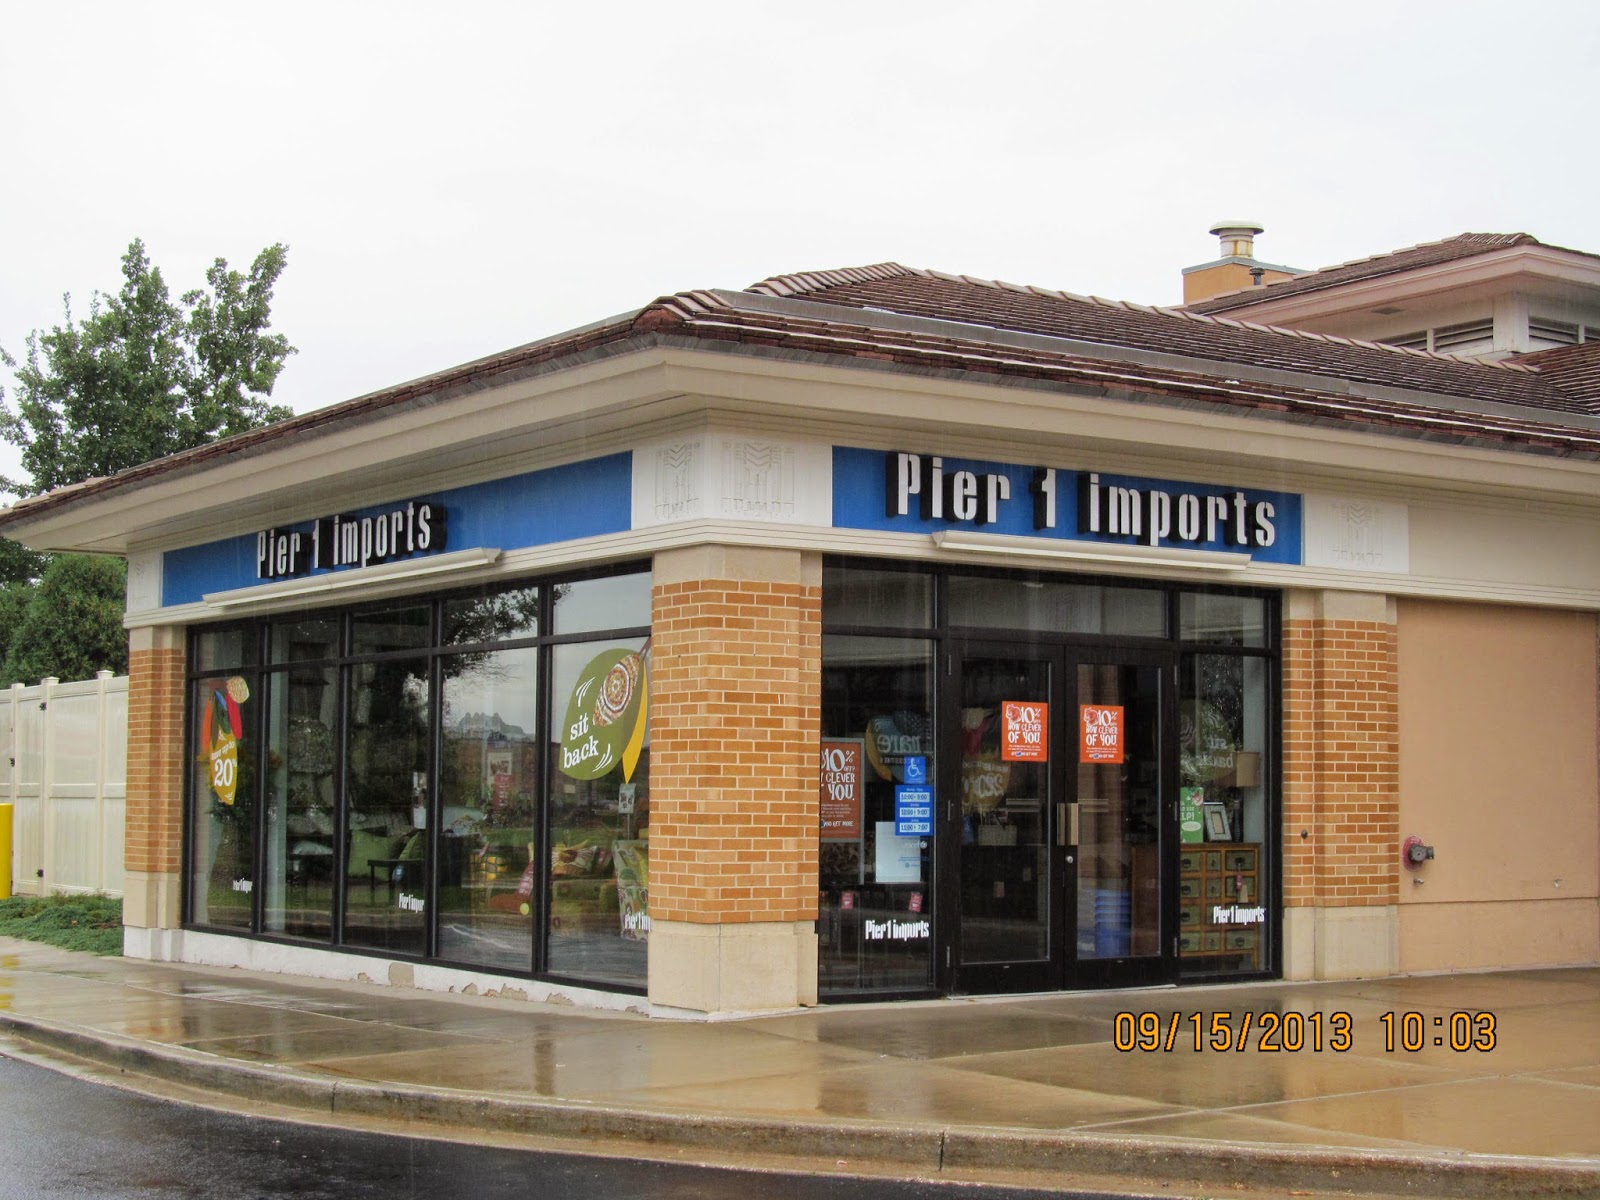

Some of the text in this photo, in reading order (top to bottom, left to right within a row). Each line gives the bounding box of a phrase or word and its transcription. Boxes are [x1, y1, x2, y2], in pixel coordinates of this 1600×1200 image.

[898, 452, 1275, 548] Pier 1 imports
[257, 501, 432, 579] Pier 1 imports
[569, 712, 589, 741] sit
[1021, 723, 1042, 732] CLEVER
[1098, 726, 1118, 735] CLEVER
[1007, 731, 1020, 744] OF
[1085, 734, 1098, 747] OF
[563, 735, 599, 769] back
[825, 772, 856, 784] CLEVER
[1235, 905, 1265, 926] imports
[892, 919, 930, 941] imports
